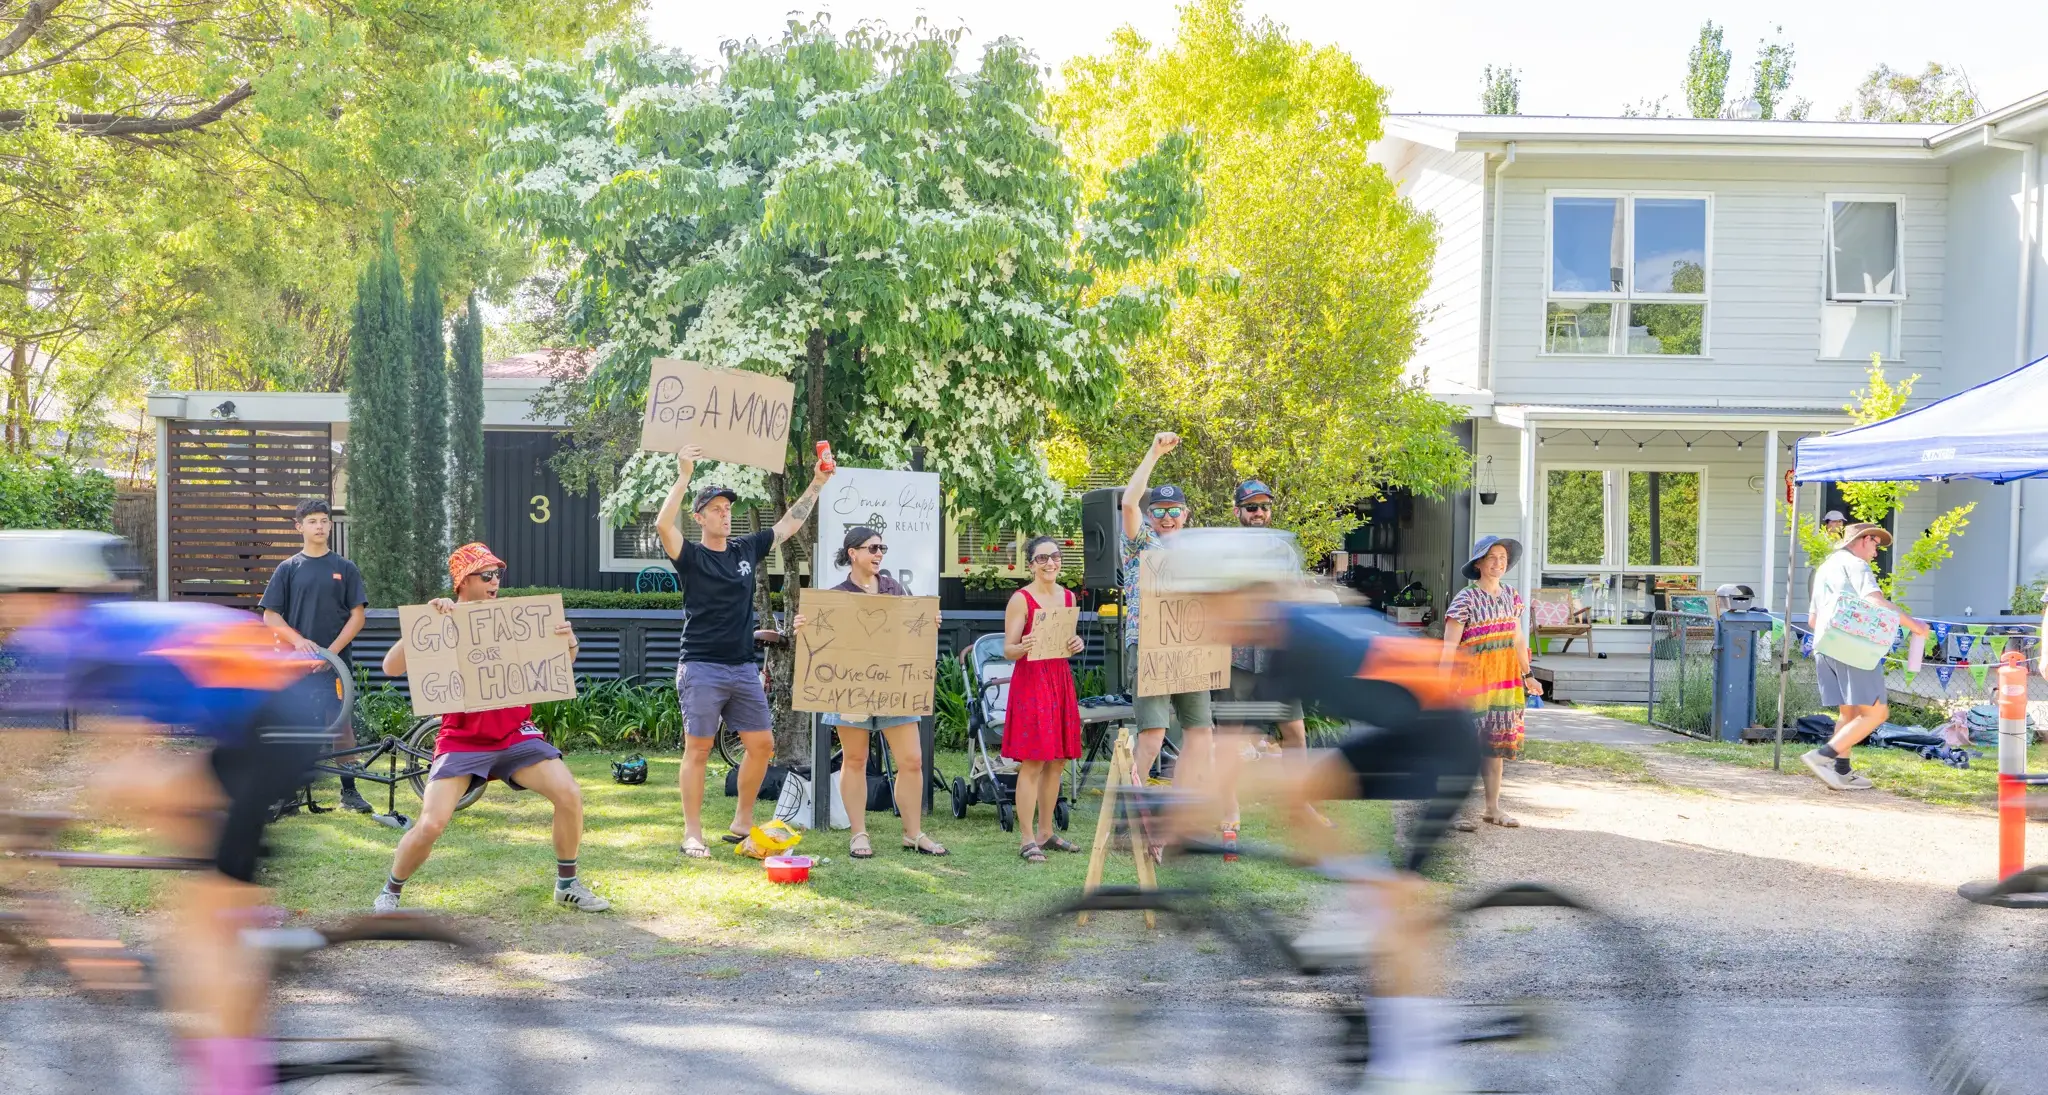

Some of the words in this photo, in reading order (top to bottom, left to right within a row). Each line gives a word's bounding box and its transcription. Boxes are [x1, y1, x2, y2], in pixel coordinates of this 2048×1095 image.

[700, 385, 720, 429] A
[729, 389, 789, 442] MONO
[529, 494, 551, 524] 3
[833, 478, 889, 515] Donna
[898, 483, 936, 519] Rupp
[895, 521, 931, 532] REALTY
[411, 614, 460, 652] GO
[468, 604, 552, 645] FAST
[467, 646, 502, 664] OR
[1733, 636, 1749, 660] 5
[421, 670, 466, 703] GO
[478, 651, 569, 701] HOME
[802, 685, 847, 712] SLAY
